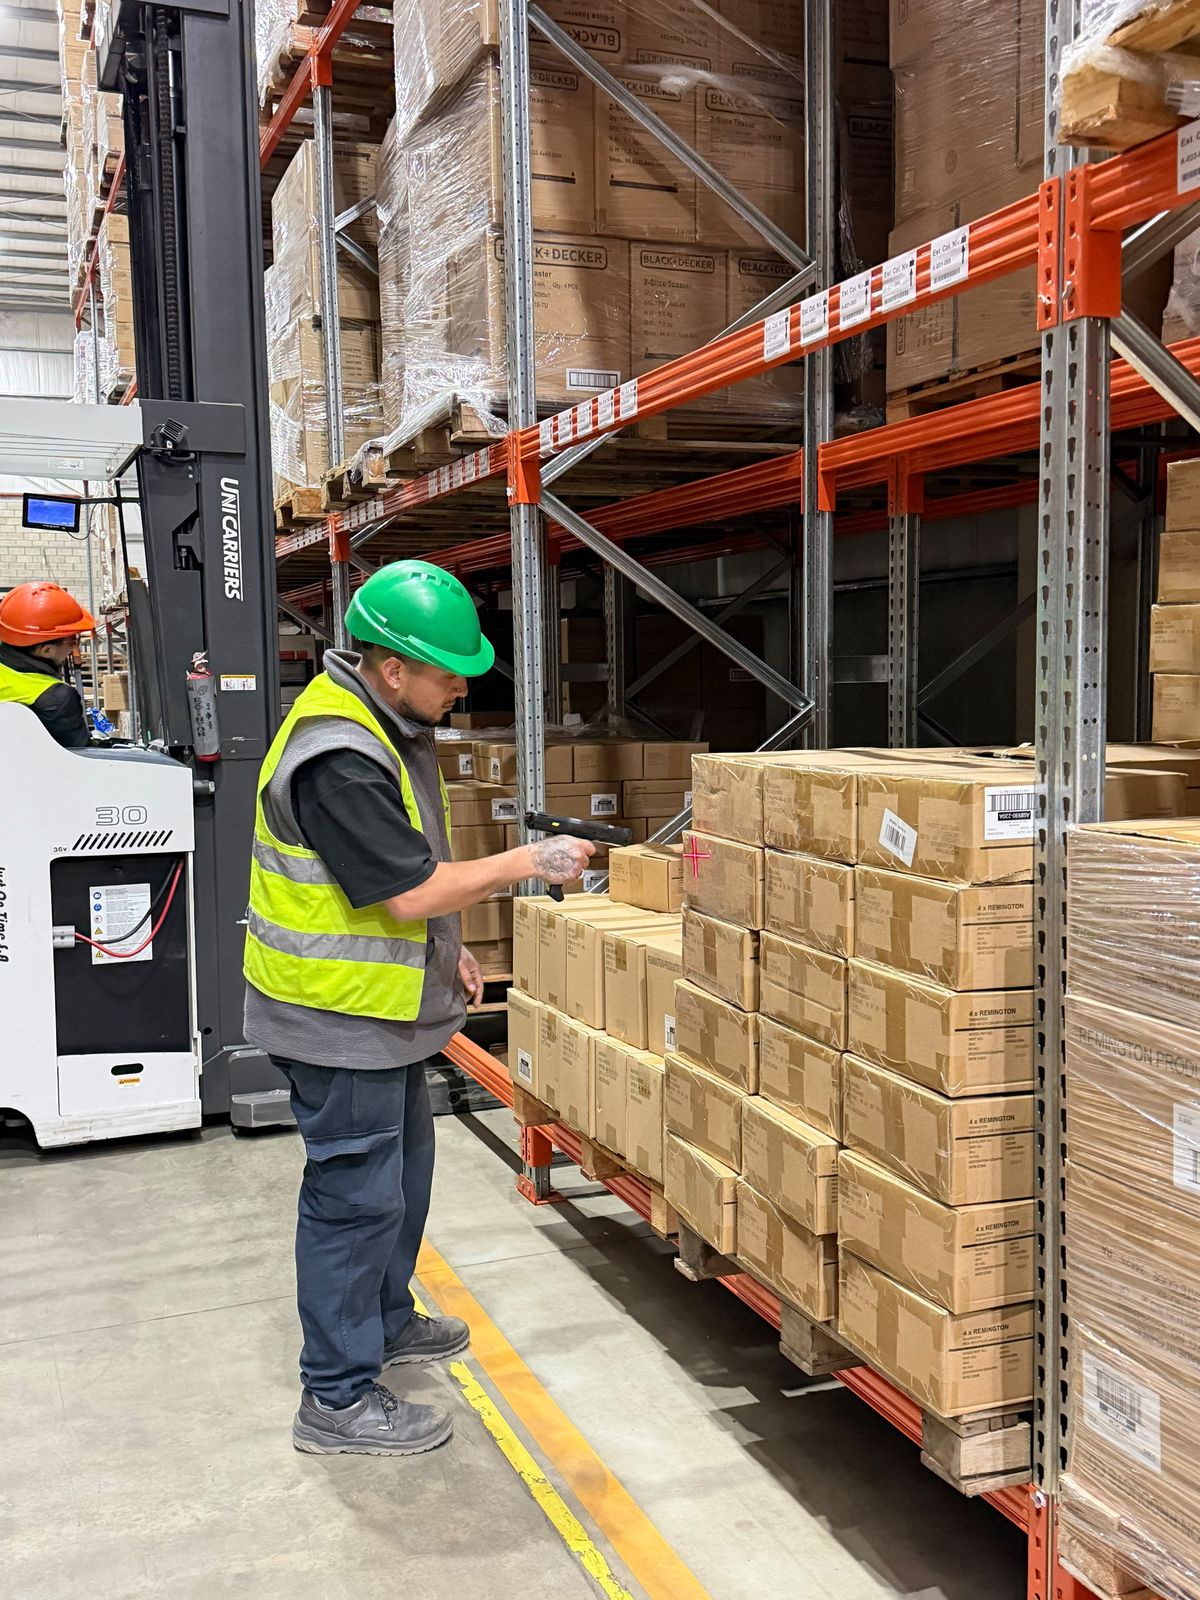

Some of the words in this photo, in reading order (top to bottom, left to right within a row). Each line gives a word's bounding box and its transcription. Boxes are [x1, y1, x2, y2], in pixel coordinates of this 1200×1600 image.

[643, 255, 713, 269] BLACK+DECKER
[220, 477, 241, 600] UNICARRIERS
[96, 806, 148, 826] 30
[987, 903, 1024, 911] REMINGTON
[980, 1008, 1016, 1016] REMINGTON
[1079, 1027, 1152, 1064] REMINGTON
[979, 1114, 1015, 1124] REMINGTON
[985, 1219, 1020, 1231] REMINGTON
[973, 1324, 1009, 1335] REMINGTON
